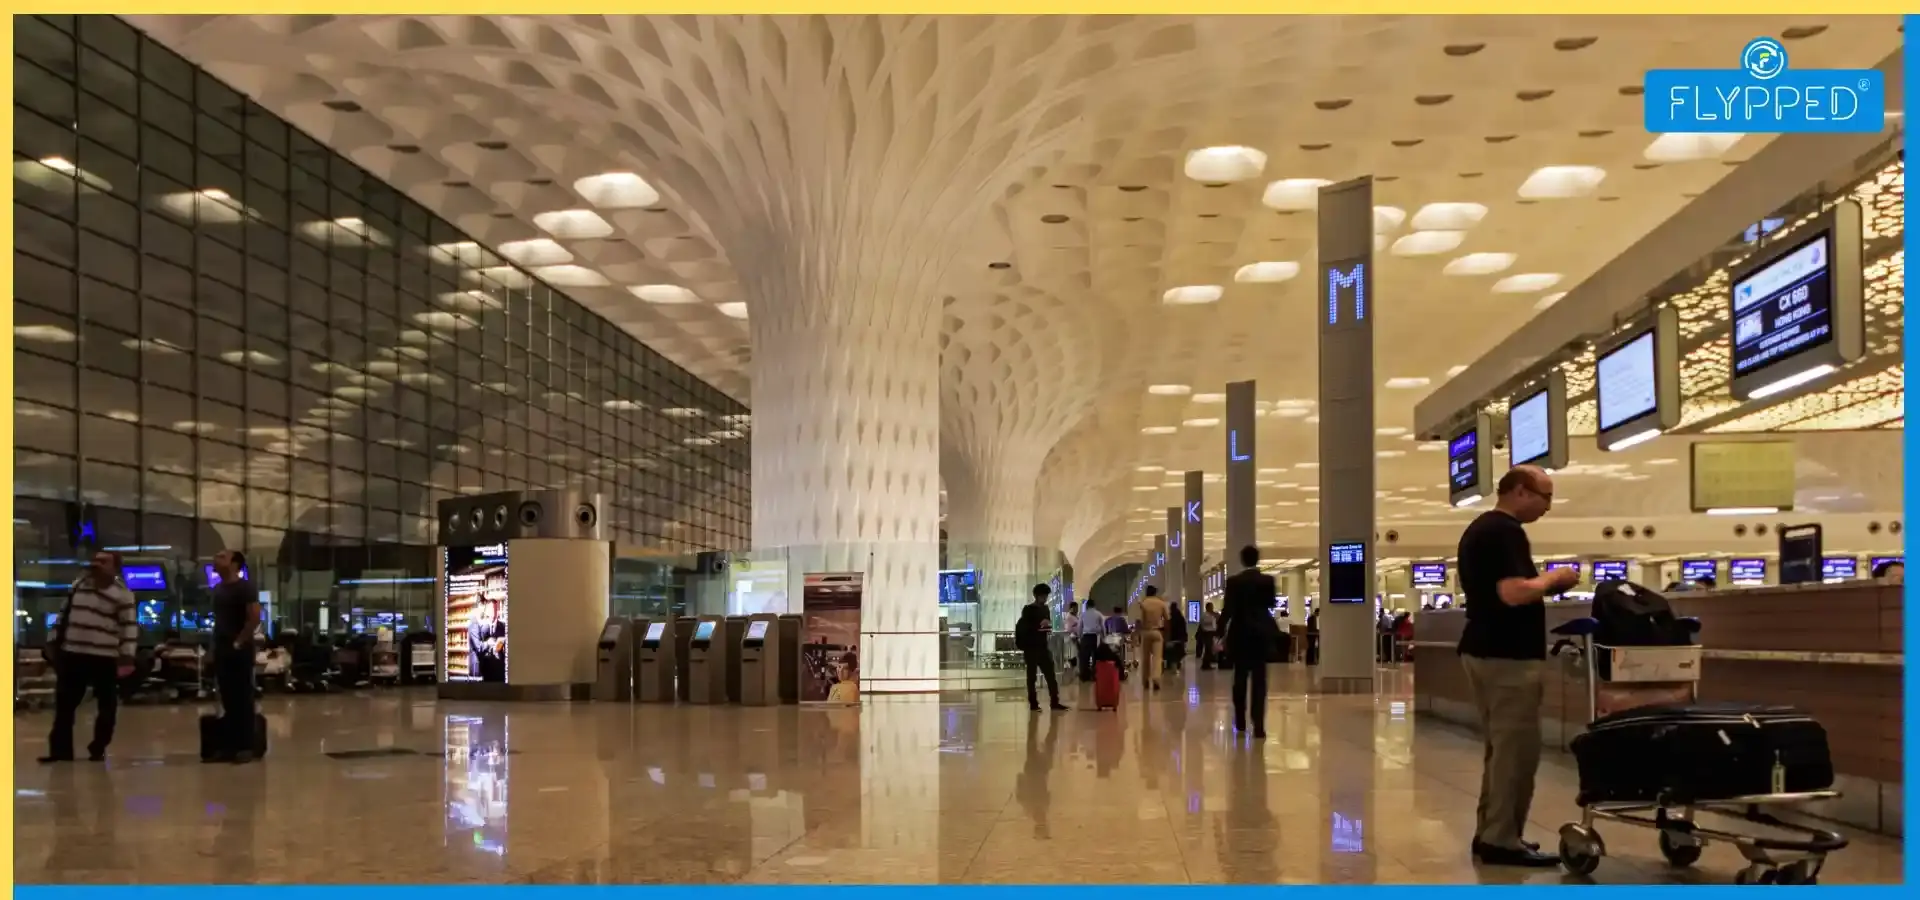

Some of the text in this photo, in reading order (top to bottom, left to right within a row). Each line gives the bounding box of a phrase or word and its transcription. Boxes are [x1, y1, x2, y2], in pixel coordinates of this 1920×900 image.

[1328, 263, 1364, 325] M
[1778, 291, 1792, 311] CX
[1231, 429, 1250, 461] L
[1187, 501, 1201, 523] K
[1170, 530, 1180, 547] J
[1156, 552, 1165, 566] H
[1149, 564, 1156, 576] G
